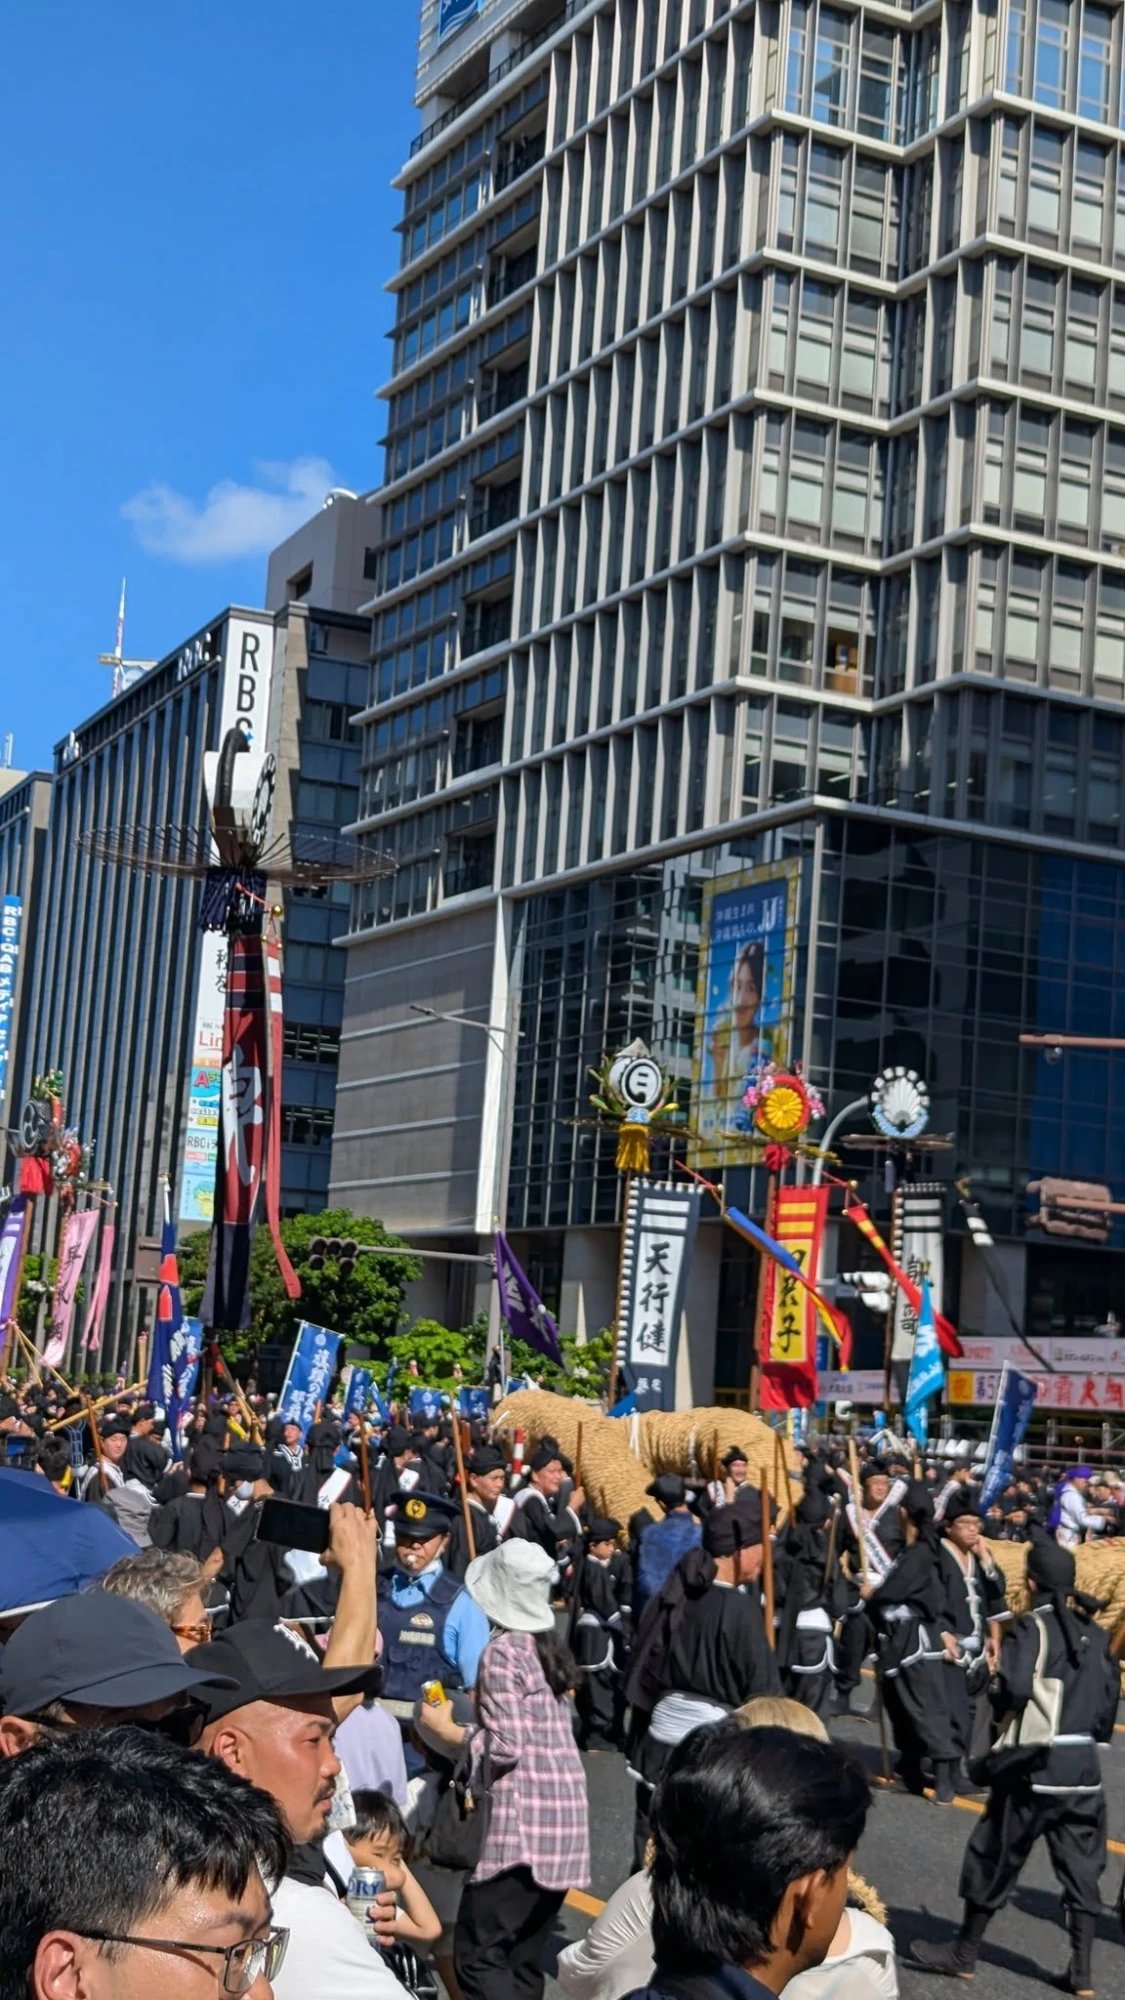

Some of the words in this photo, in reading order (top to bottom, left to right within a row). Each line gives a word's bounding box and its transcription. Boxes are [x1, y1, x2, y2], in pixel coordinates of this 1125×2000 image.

[635, 1241, 672, 1354] 天行健
[347, 1878, 381, 1896] DRY
